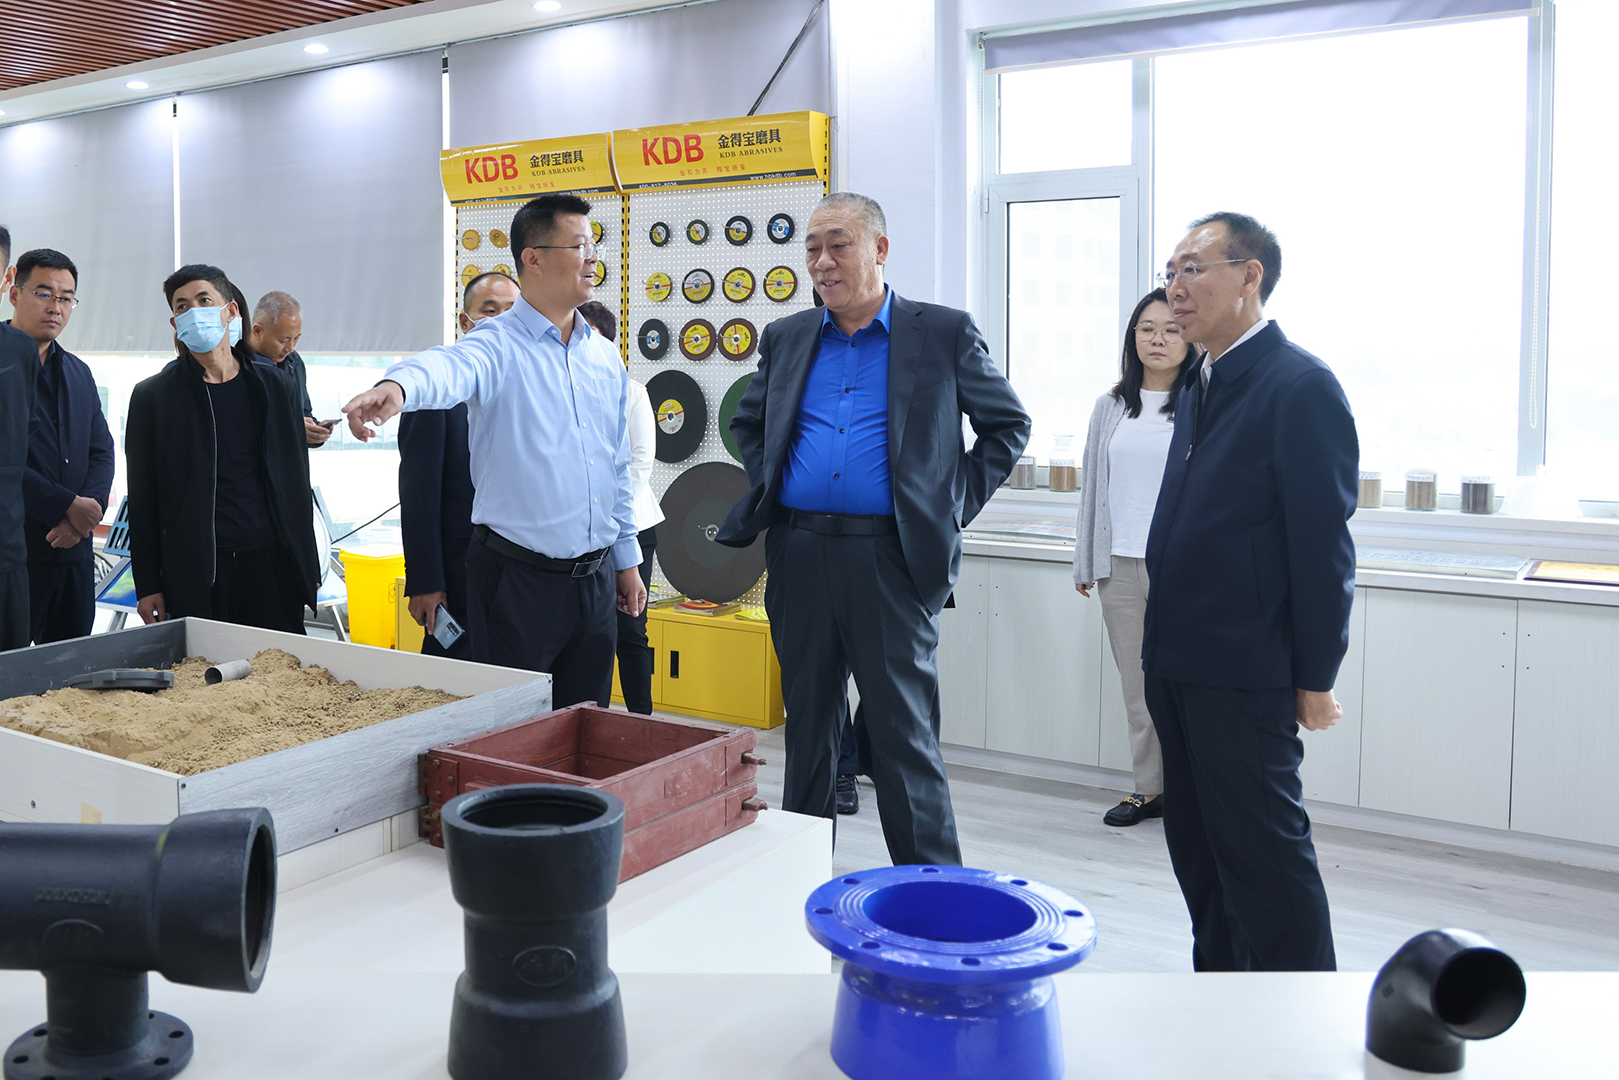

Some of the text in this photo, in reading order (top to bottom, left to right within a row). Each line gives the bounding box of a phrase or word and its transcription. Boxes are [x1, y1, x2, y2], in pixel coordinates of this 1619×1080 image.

[718, 128, 782, 149] 金得宝磨具
[530, 150, 584, 168] 金得宝磨具
[642, 133, 704, 166] KDB
[719, 146, 783, 159] KDB ABRASIVES
[465, 154, 519, 184] KDB
[548, 165, 586, 175] ABRASIVES
